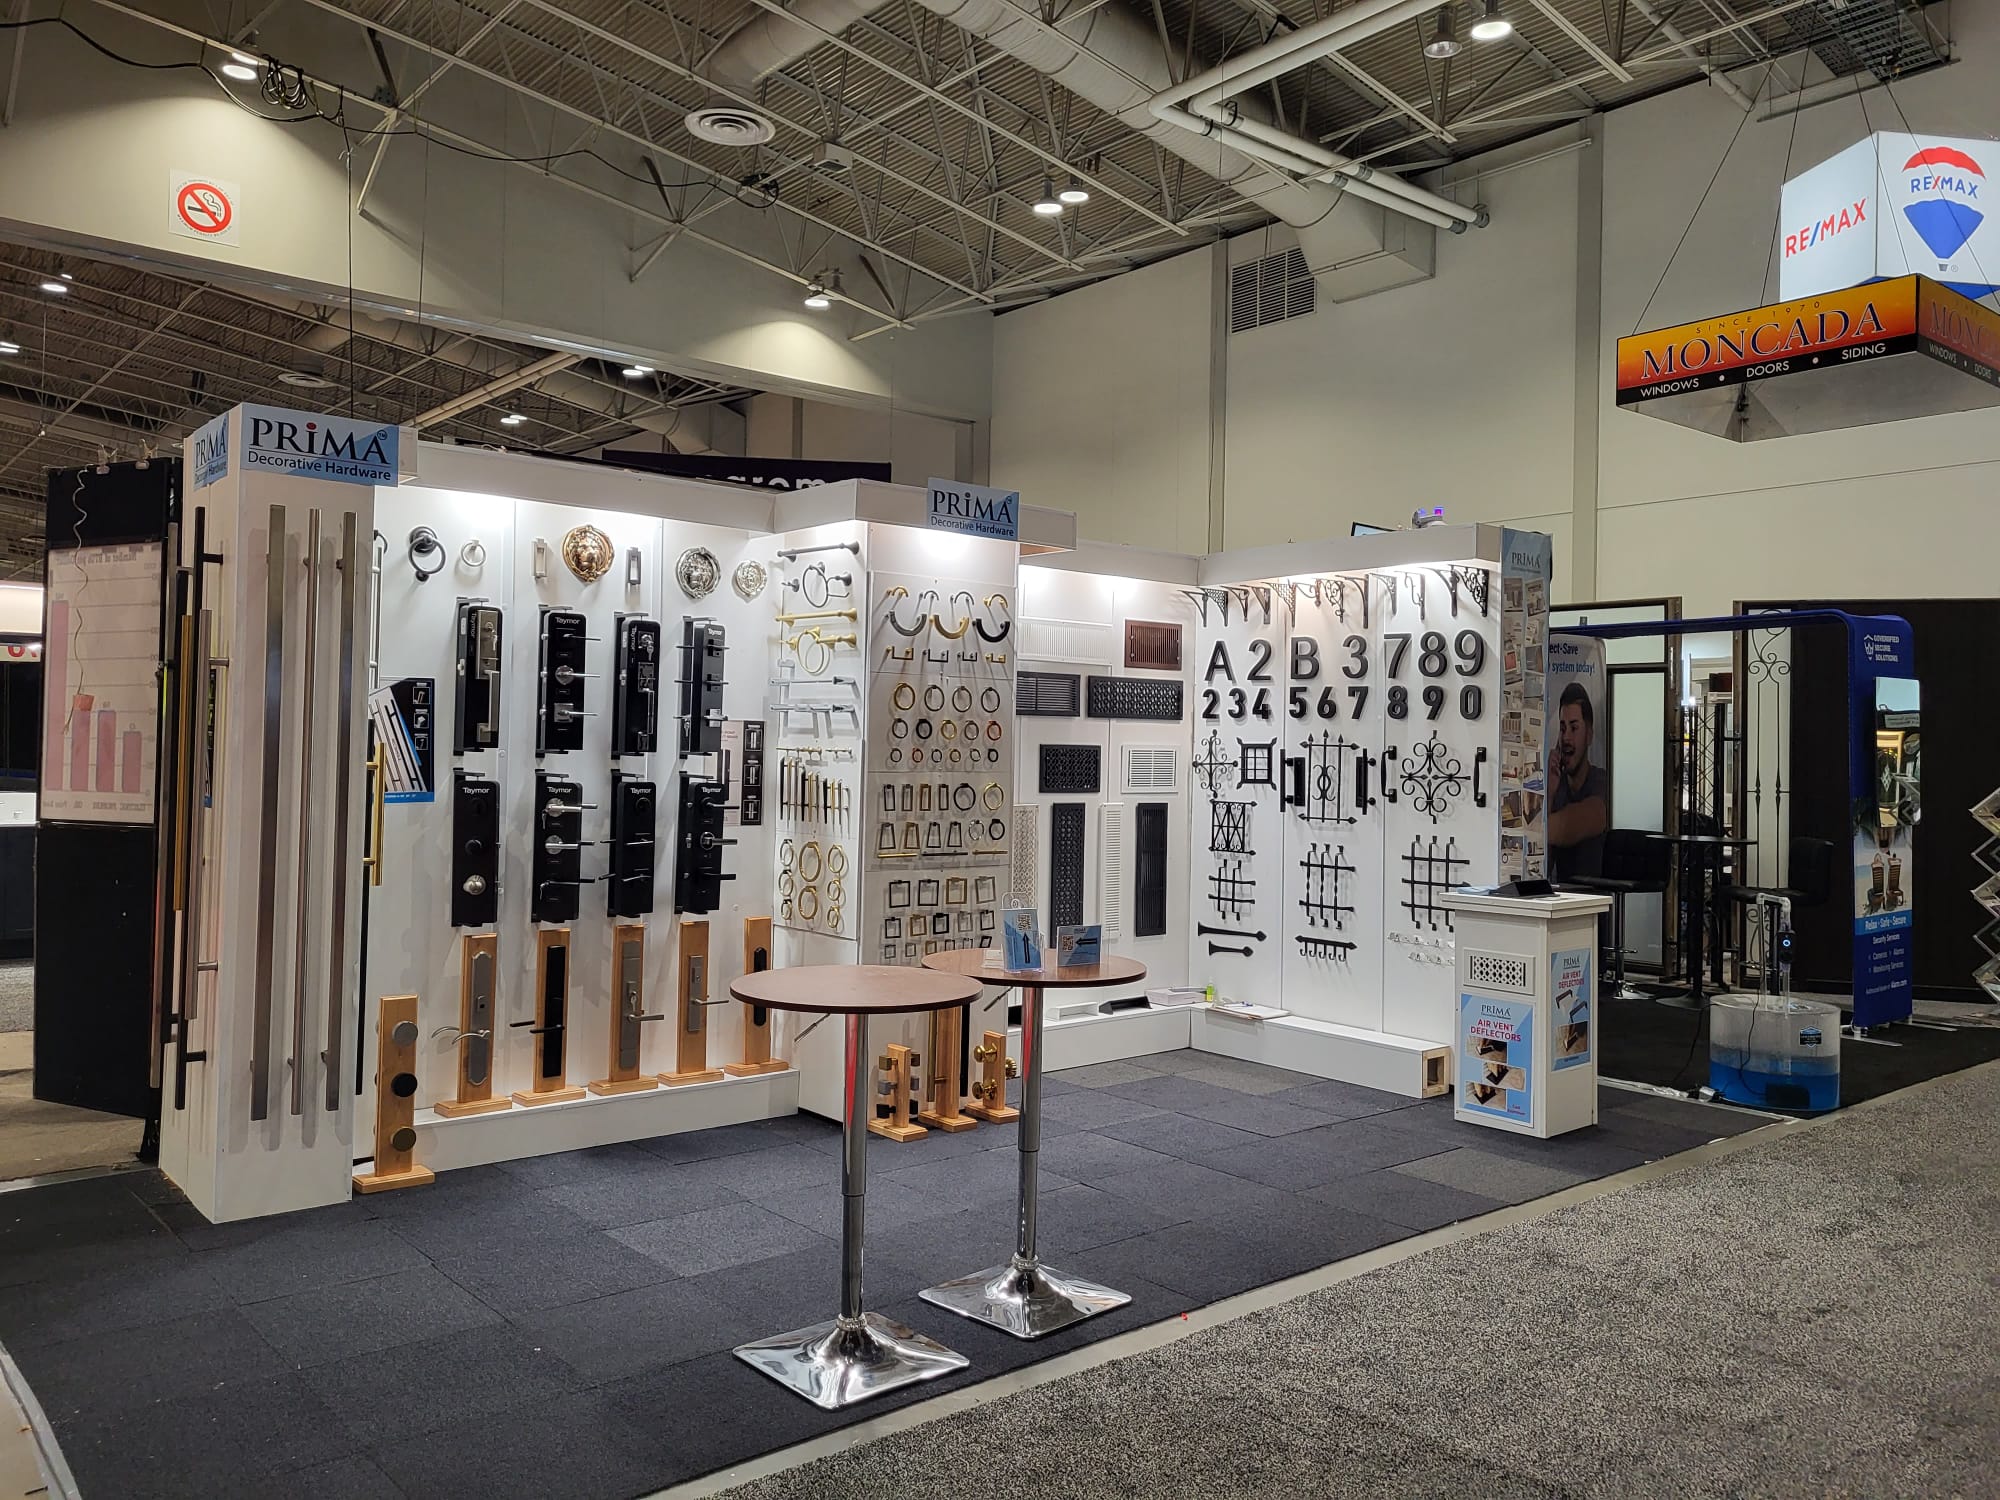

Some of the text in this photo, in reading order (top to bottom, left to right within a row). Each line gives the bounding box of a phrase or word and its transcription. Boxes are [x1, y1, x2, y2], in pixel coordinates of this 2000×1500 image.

[1911, 176, 1978, 199] RE/MAX
[1785, 198, 1866, 258] RE/MAX
[1695, 301, 1820, 334] SINCE 1970
[1641, 301, 1886, 380] MONCADA
[1929, 342, 1992, 379] WINDOWS DOORS
[1640, 343, 1886, 397] WINDOWS DOORS SIDING
[248, 451, 392, 481] Decorative Hardware
[931, 516, 1014, 537] Decorative Hardware
[554, 616, 581, 626] Taymor
[1552, 662, 1595, 676] system today!
[462, 787, 490, 796] Taymor
[547, 786, 572, 795] Taymor
[631, 786, 651, 795] Taymor
[701, 786, 721, 794] Taymor
[1562, 970, 1581, 980] AIR VENT
[1558, 977, 1585, 989] DEFLECTORS
[1477, 1018, 1515, 1032] AIR VENT
[1470, 1026, 1522, 1042] DEFLECTORS
